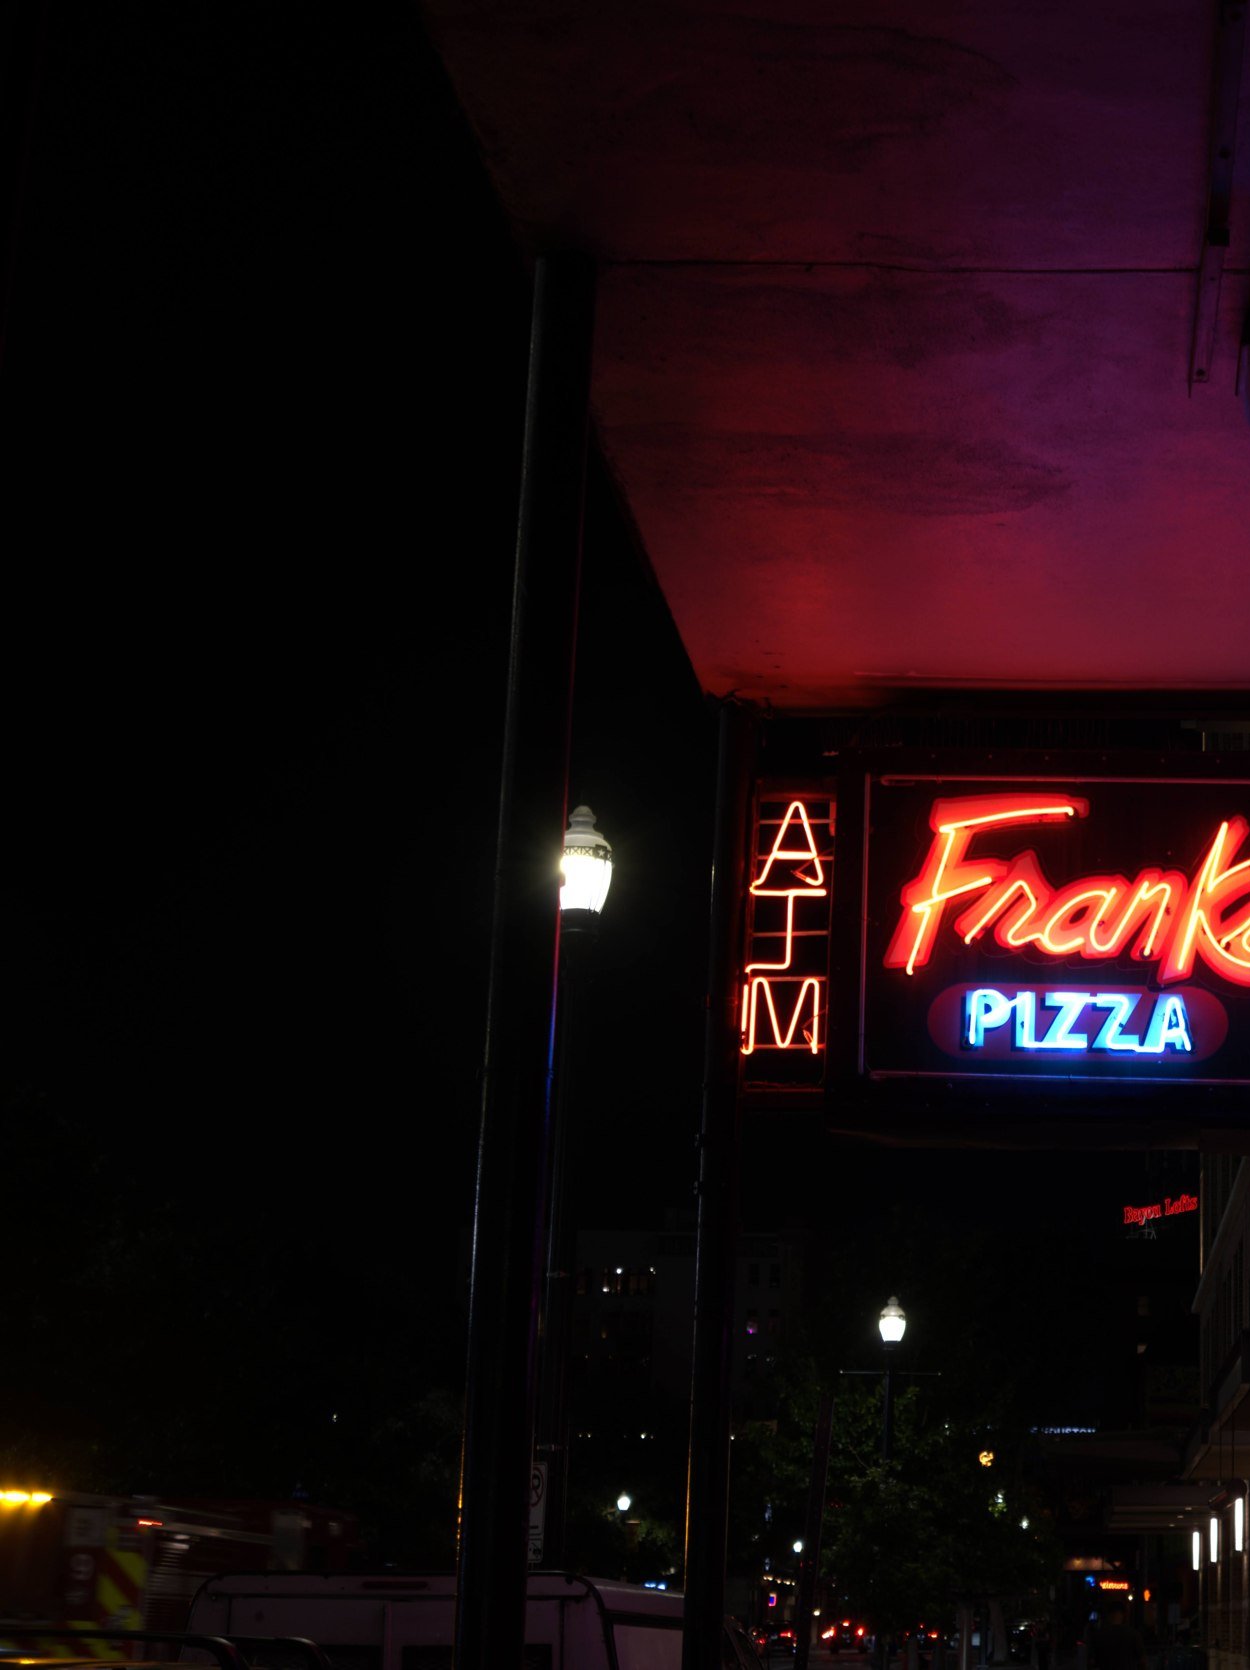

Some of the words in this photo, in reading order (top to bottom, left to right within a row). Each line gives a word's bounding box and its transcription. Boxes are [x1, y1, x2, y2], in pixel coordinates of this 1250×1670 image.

[741, 800, 828, 1056] ATM
[965, 988, 1194, 1054] PIZZA
[1164, 1193, 1198, 1216] Lofts
